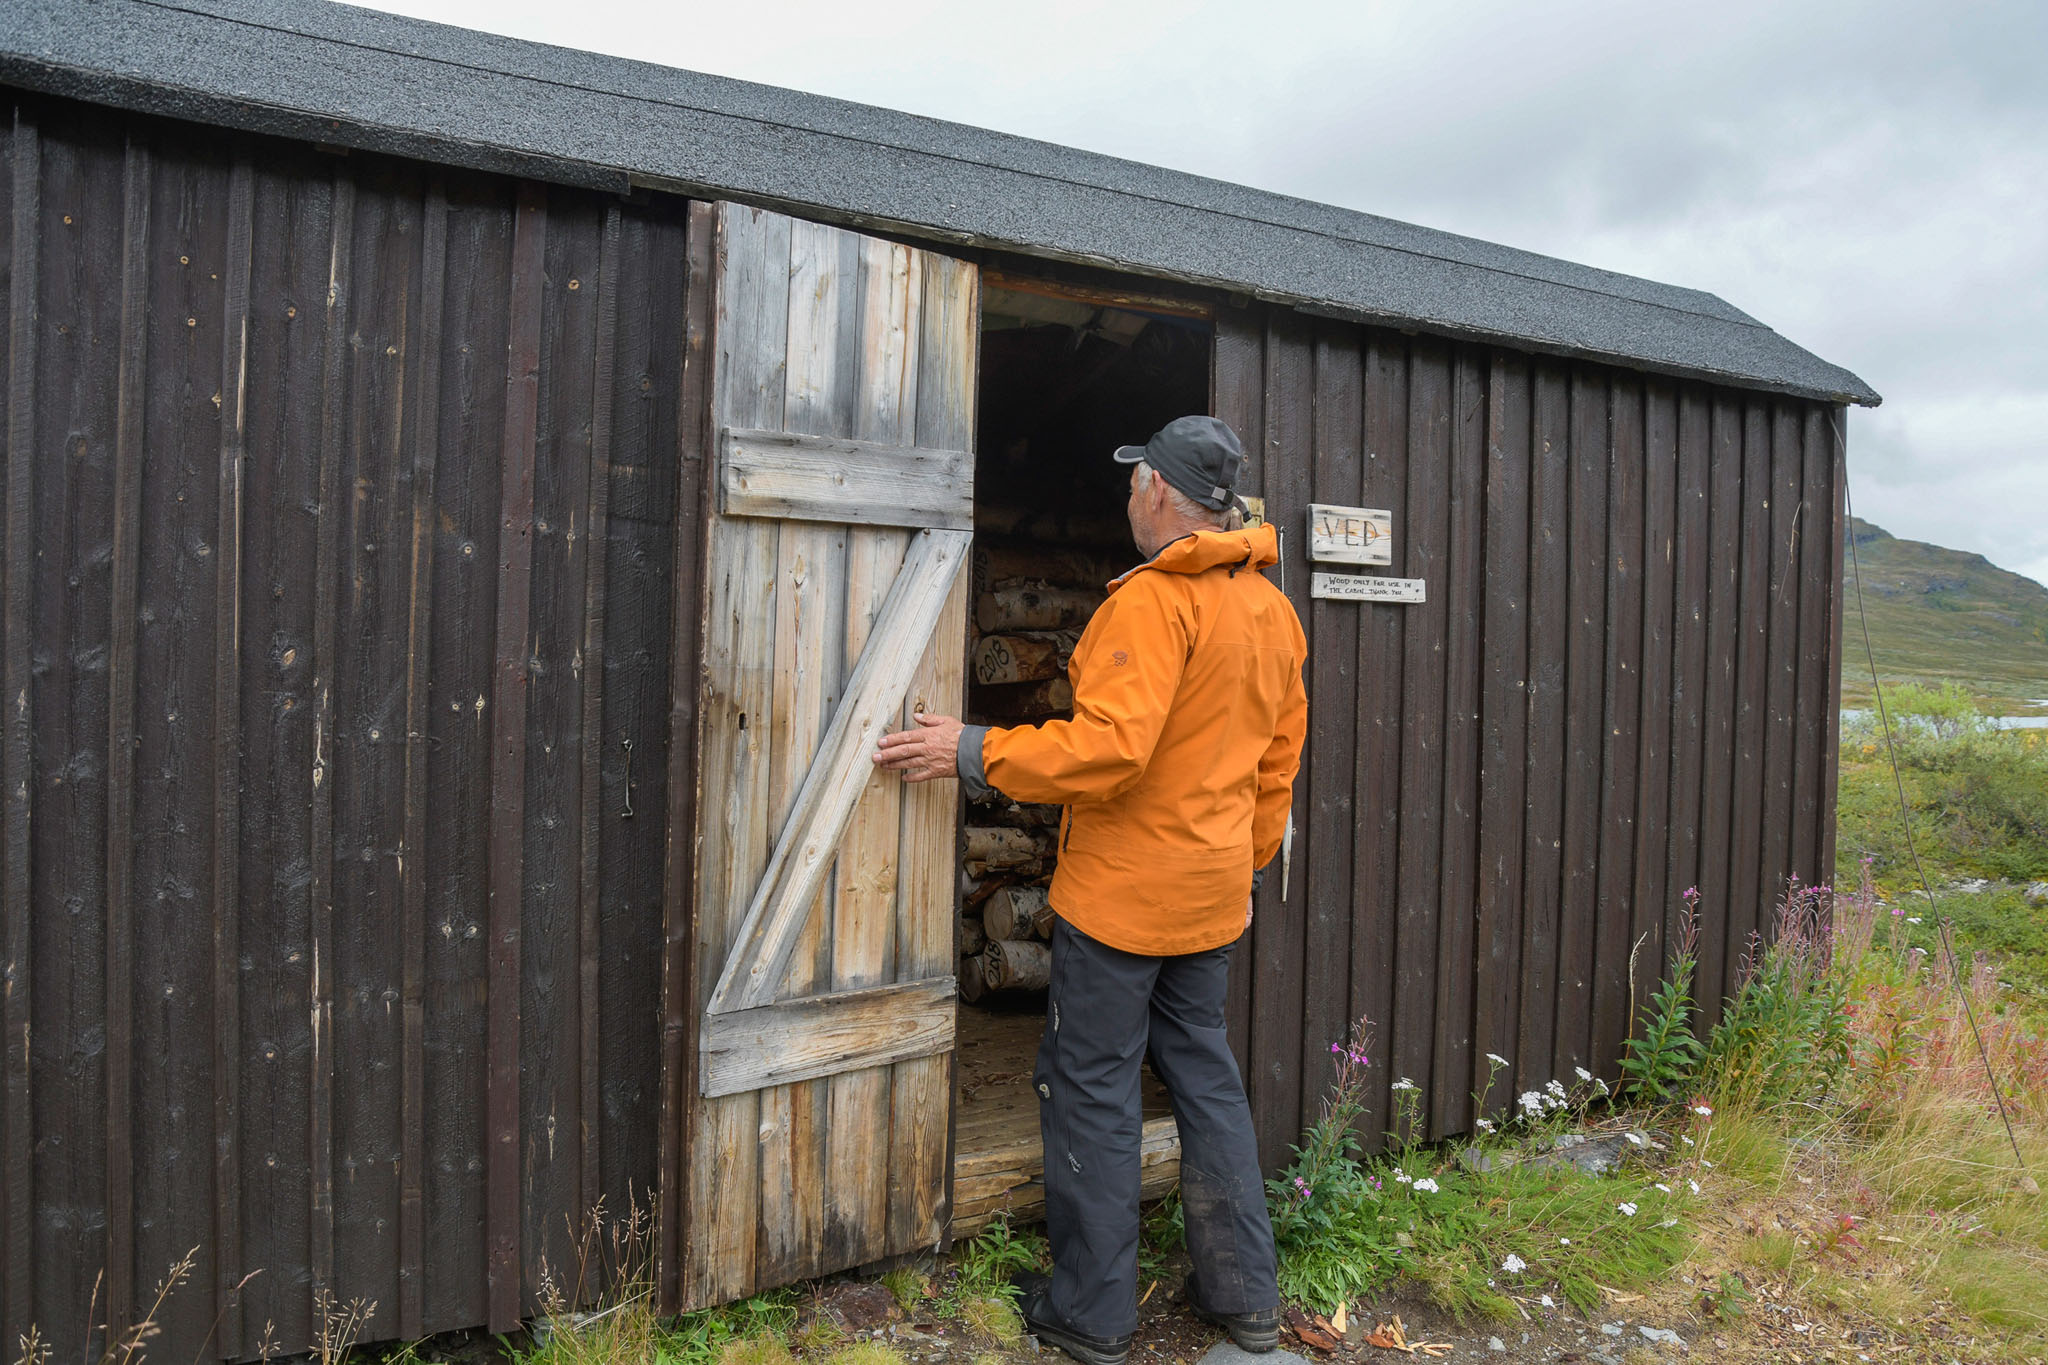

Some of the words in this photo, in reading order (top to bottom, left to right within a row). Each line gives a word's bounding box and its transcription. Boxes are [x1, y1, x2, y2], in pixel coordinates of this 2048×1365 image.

[1323, 517, 1378, 546] VED
[1329, 577, 1350, 586] WOOD
[1373, 579, 1385, 587] FOR
[979, 639, 1009, 682] 2018
[984, 942, 1001, 985] 2018
